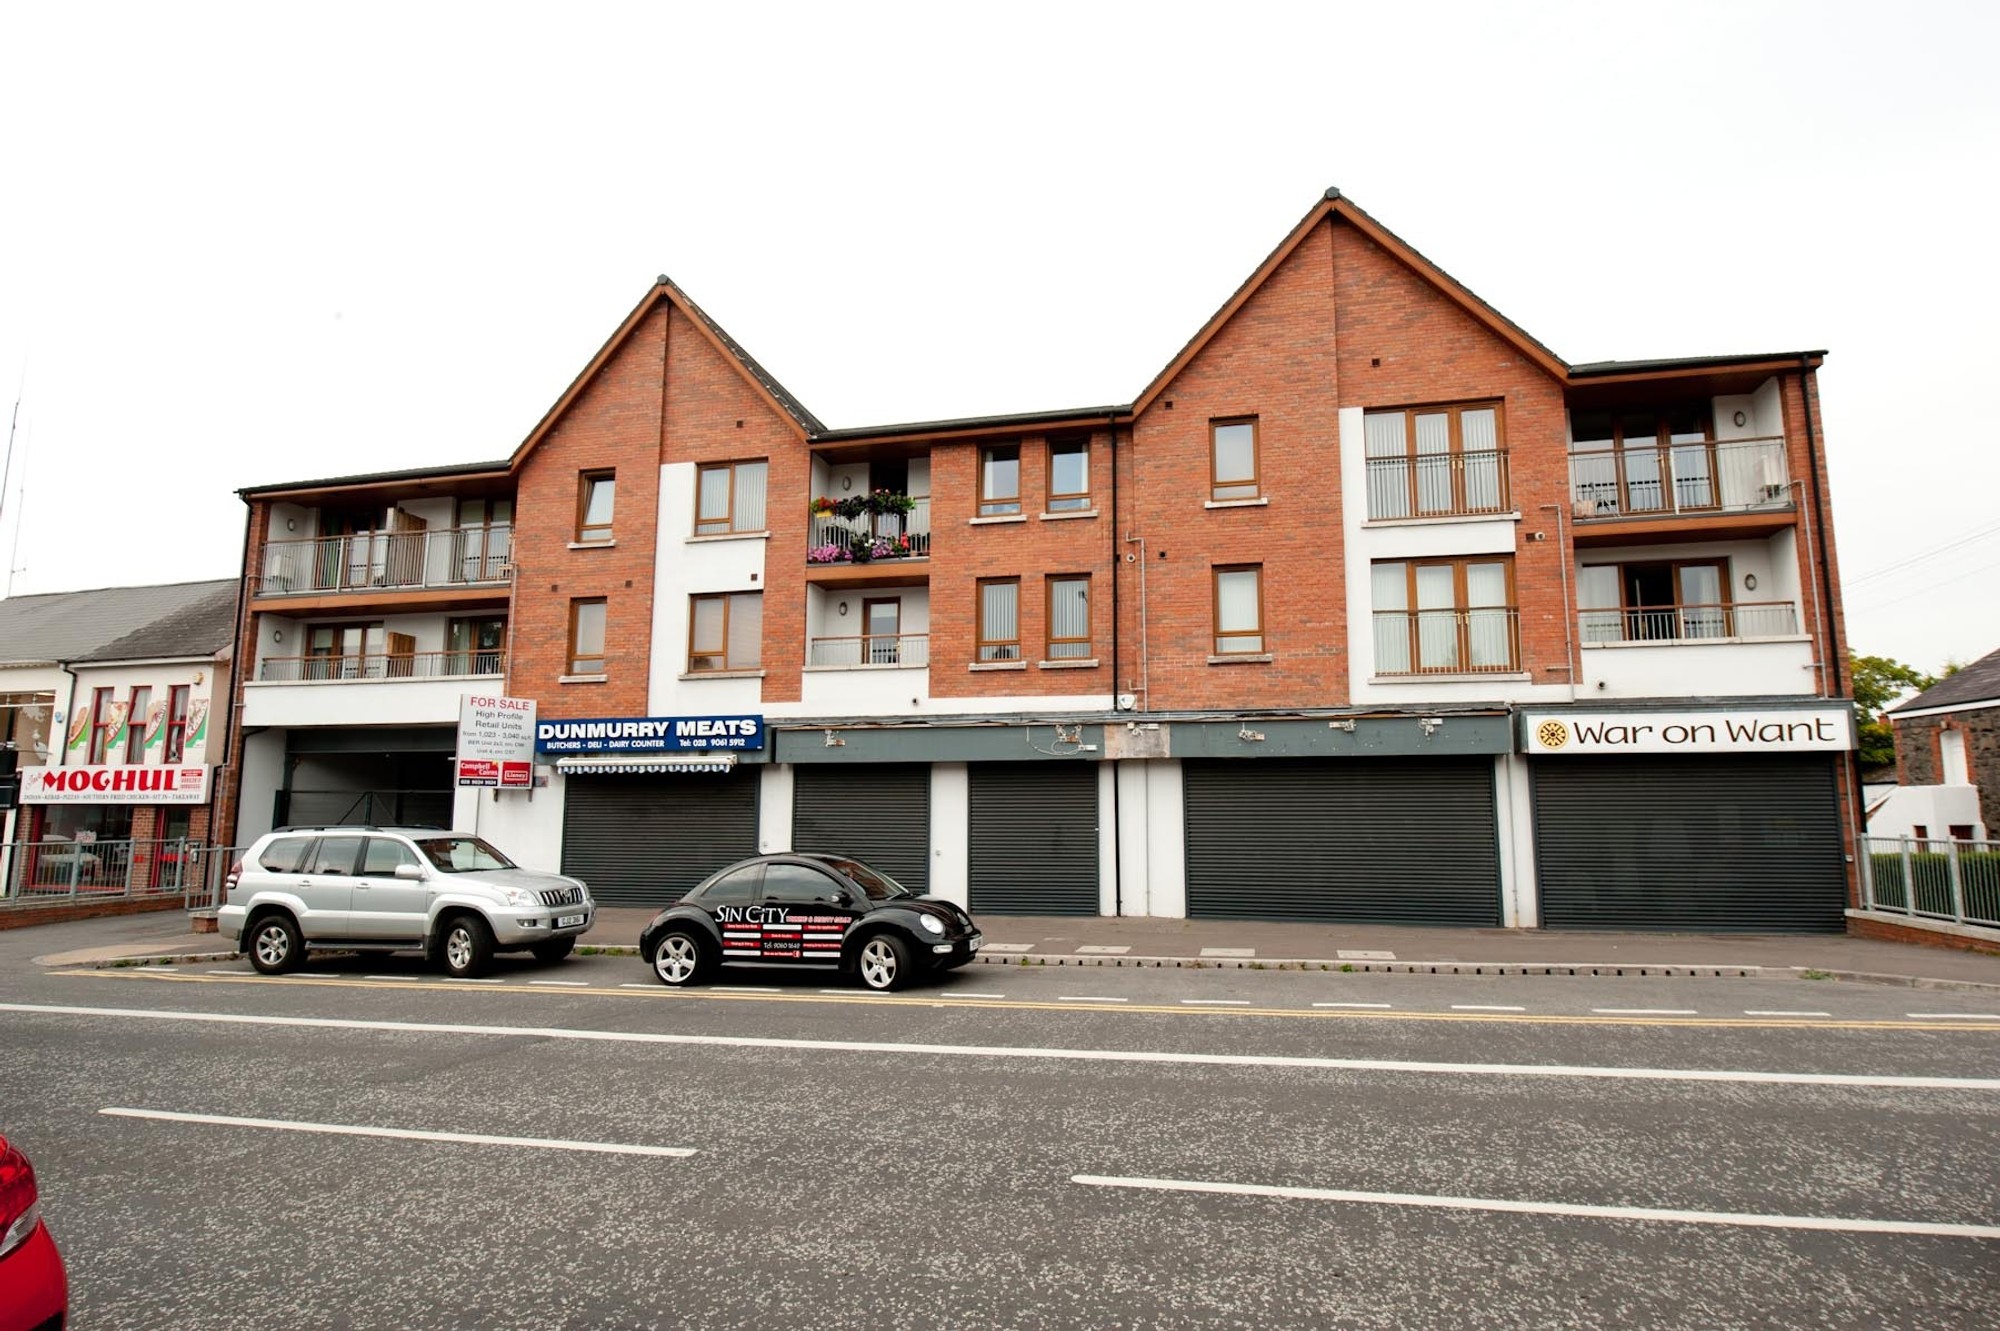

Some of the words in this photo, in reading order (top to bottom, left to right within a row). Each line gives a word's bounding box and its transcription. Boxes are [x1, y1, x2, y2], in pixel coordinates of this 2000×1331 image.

[470, 696, 496, 708] FOR
[499, 699, 530, 711] SALE
[475, 710, 496, 719] High
[497, 711, 524, 720] Profile
[475, 720, 499, 728] Retail
[501, 722, 523, 730] Units
[538, 721, 670, 739] DUNMURRY
[675, 719, 757, 737] MEATS
[1574, 721, 1653, 744] War
[1662, 724, 1716, 744] on
[1725, 717, 1836, 743] Want
[546, 741, 581, 749] BUTCHERS
[608, 740, 629, 748] DAIRY
[631, 740, 665, 748] COUNTER
[679, 739, 692, 747] Tel:
[692, 739, 707, 747] 028
[710, 738, 727, 746] 9061
[728, 738, 746, 746] 5912
[461, 762, 491, 771] Campbell
[42, 769, 178, 792] MOGHUL
[715, 905, 743, 922] SIN
